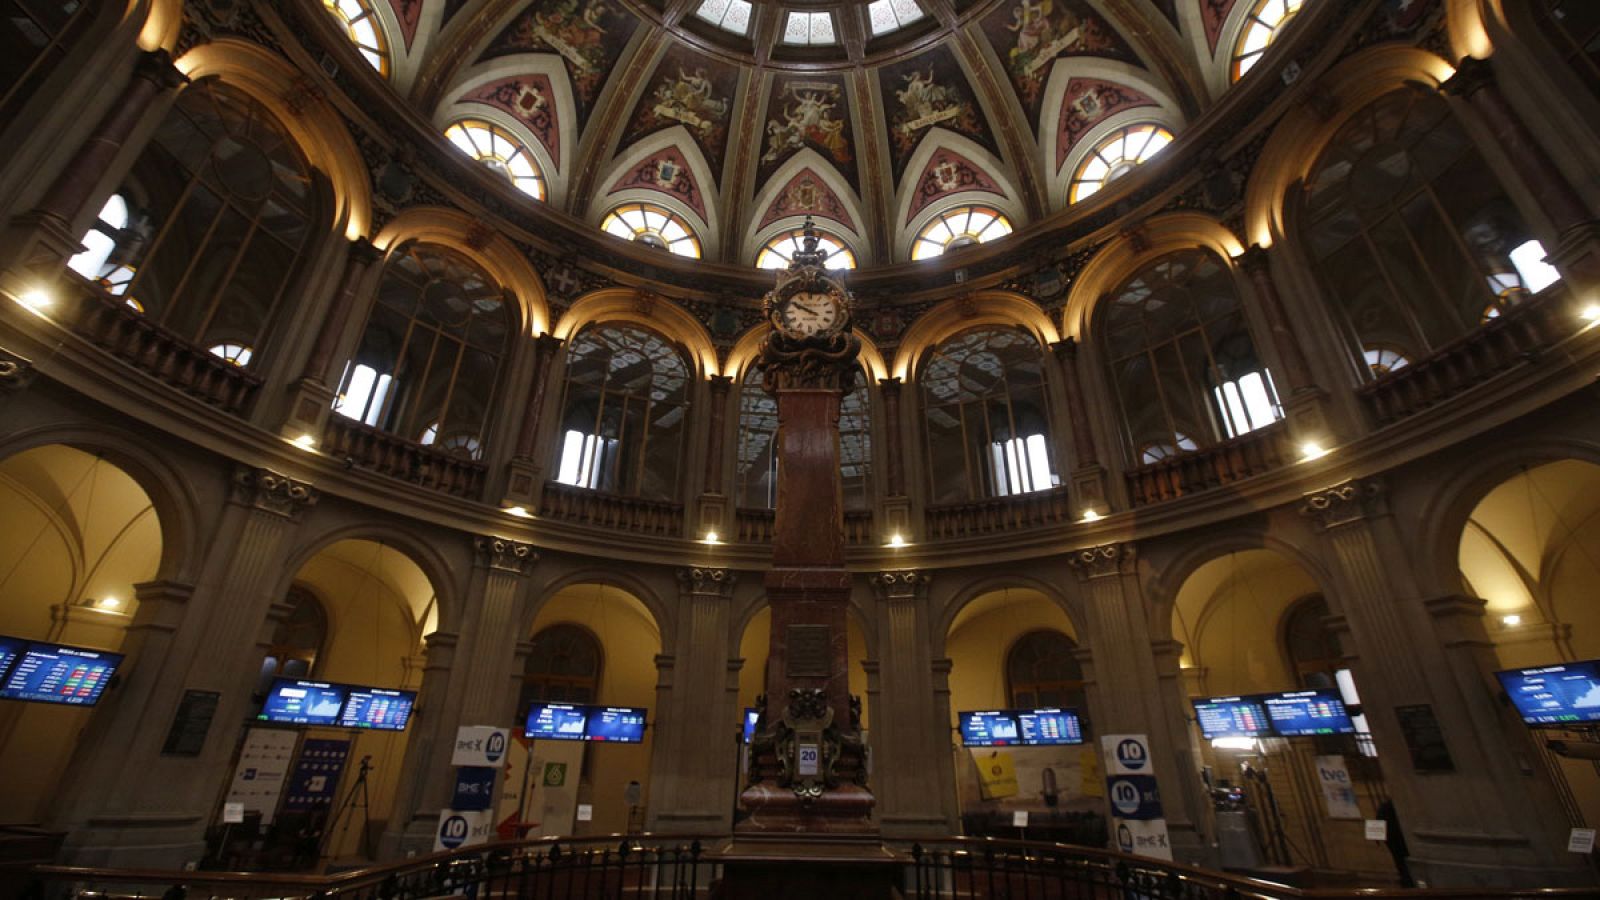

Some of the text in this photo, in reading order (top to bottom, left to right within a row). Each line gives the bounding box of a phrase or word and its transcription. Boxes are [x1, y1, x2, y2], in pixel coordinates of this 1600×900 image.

[490, 736, 502, 751] 10
[1121, 742, 1141, 760] 10
[801, 751, 817, 761] 20
[1320, 767, 1347, 783] tve
[1116, 784, 1135, 801] 10
[446, 819, 465, 837] 10
